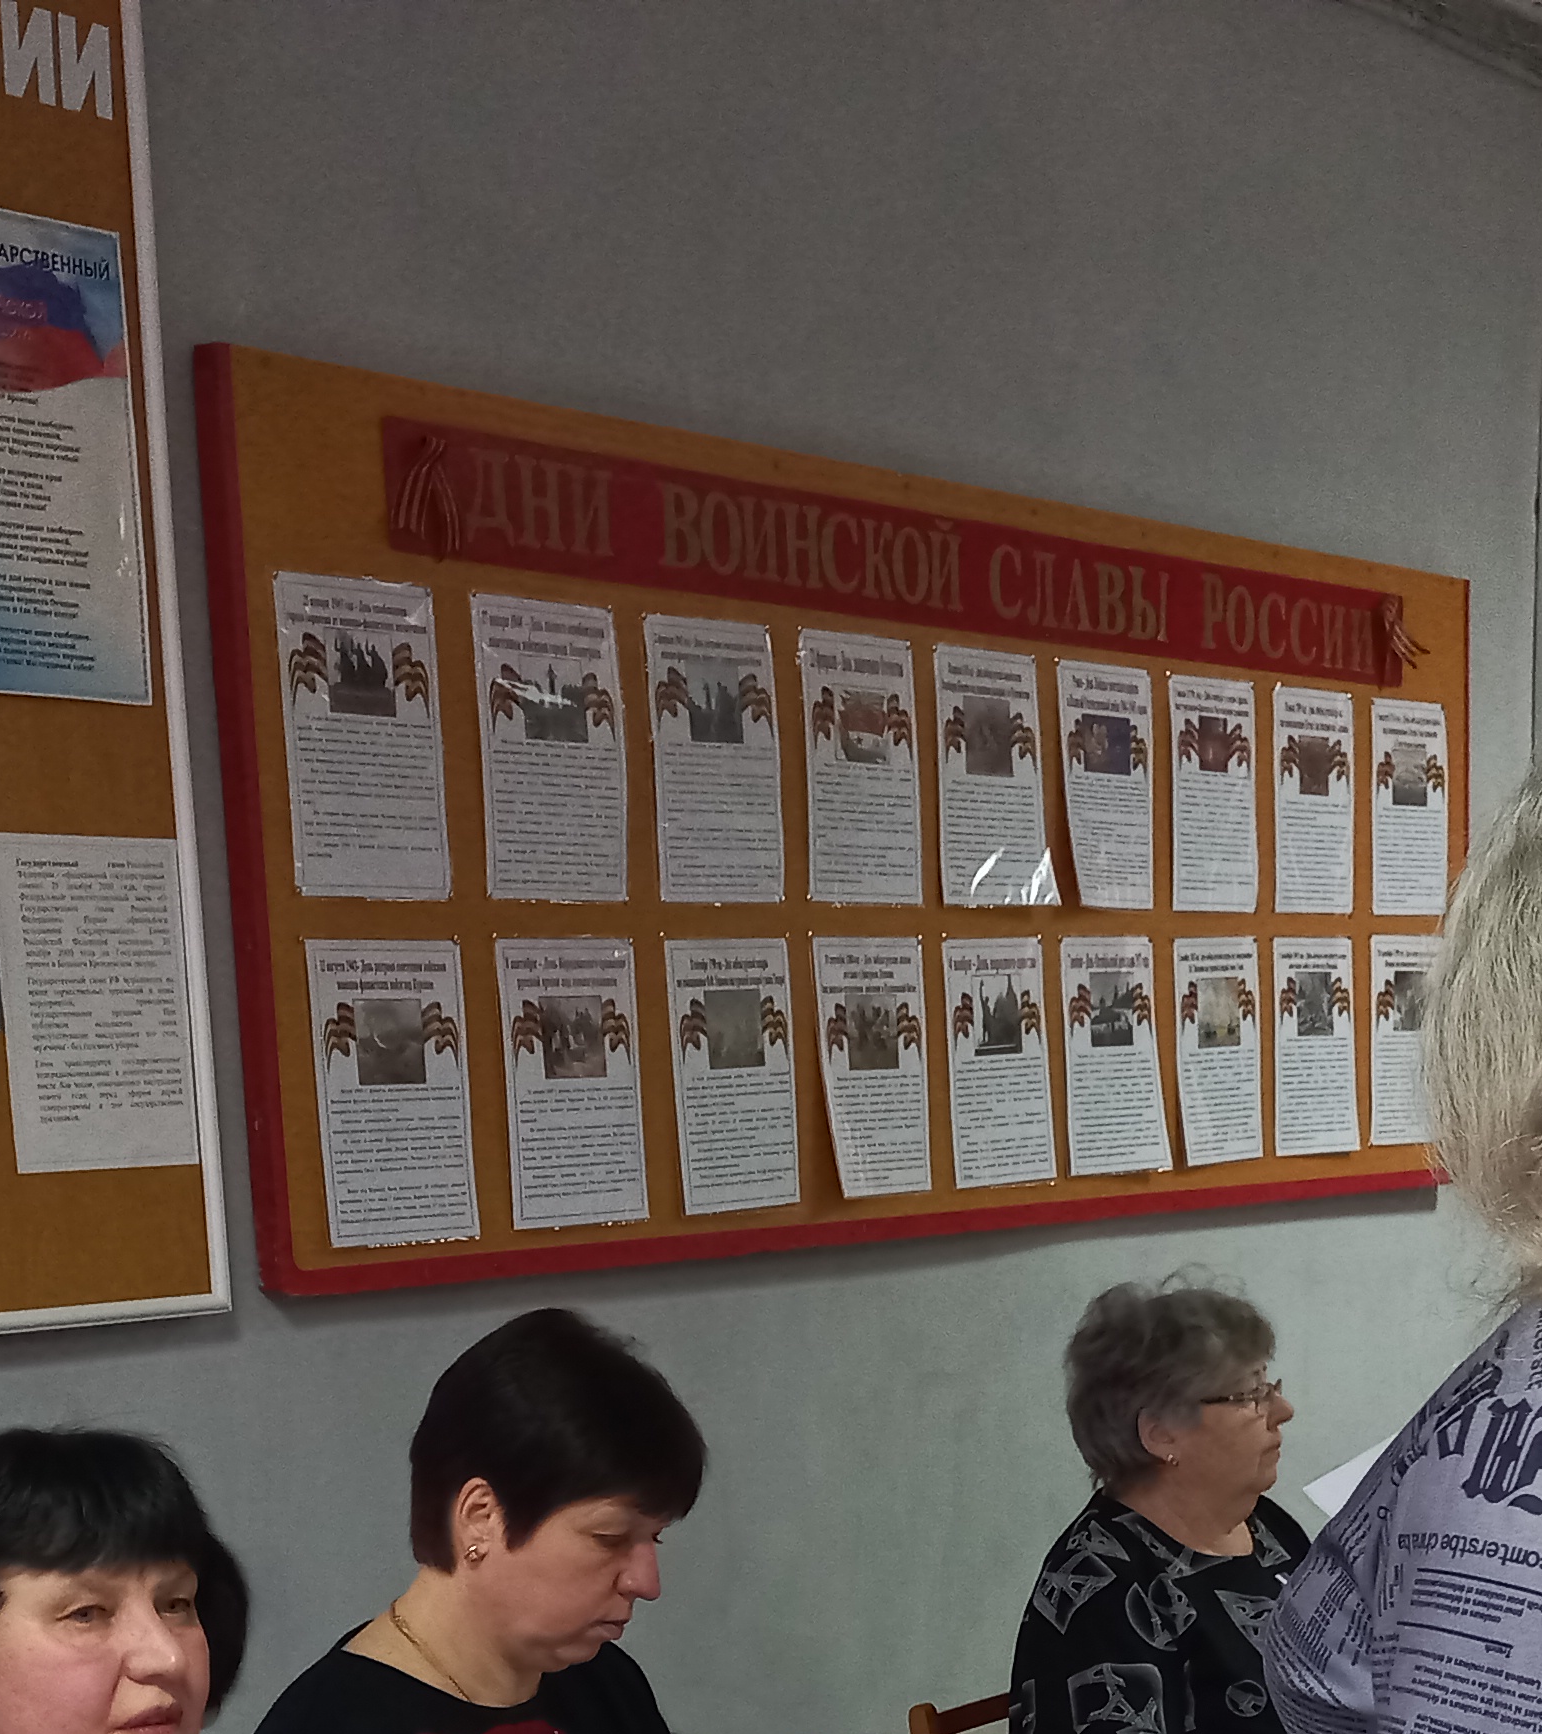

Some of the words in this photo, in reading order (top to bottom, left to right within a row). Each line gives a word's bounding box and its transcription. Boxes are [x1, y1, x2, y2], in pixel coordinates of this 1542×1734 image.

[466, 446, 614, 559] ДНИ
[660, 479, 963, 613] ВОИНСКОЙ
[988, 545, 1170, 643] СЛАВЫ
[1199, 571, 1376, 674] РОССИИ
